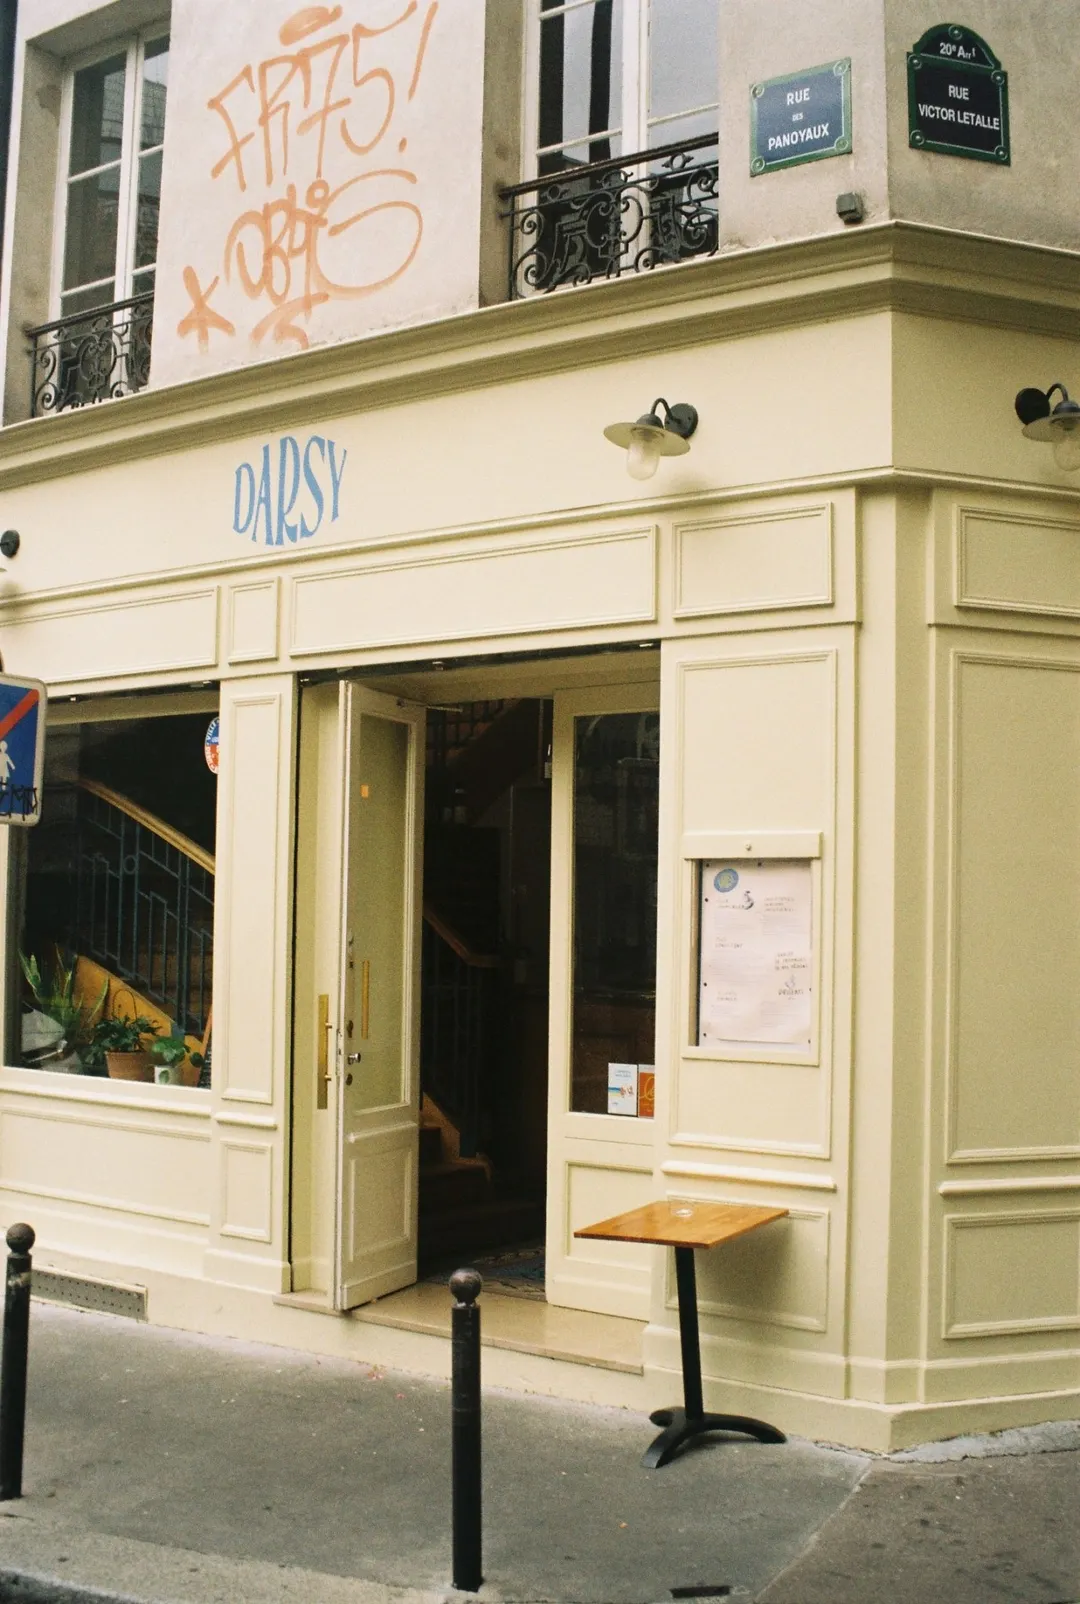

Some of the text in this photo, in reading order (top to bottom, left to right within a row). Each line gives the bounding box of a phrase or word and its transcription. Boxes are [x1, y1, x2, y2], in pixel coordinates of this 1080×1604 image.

[786, 87, 811, 106] RUE
[948, 84, 970, 101] RUE
[792, 112, 804, 122] DES
[918, 103, 1000, 131] VICTOR LETALLE
[767, 122, 829, 151] PANOYAUX
[232, 435, 347, 546] DARSY
